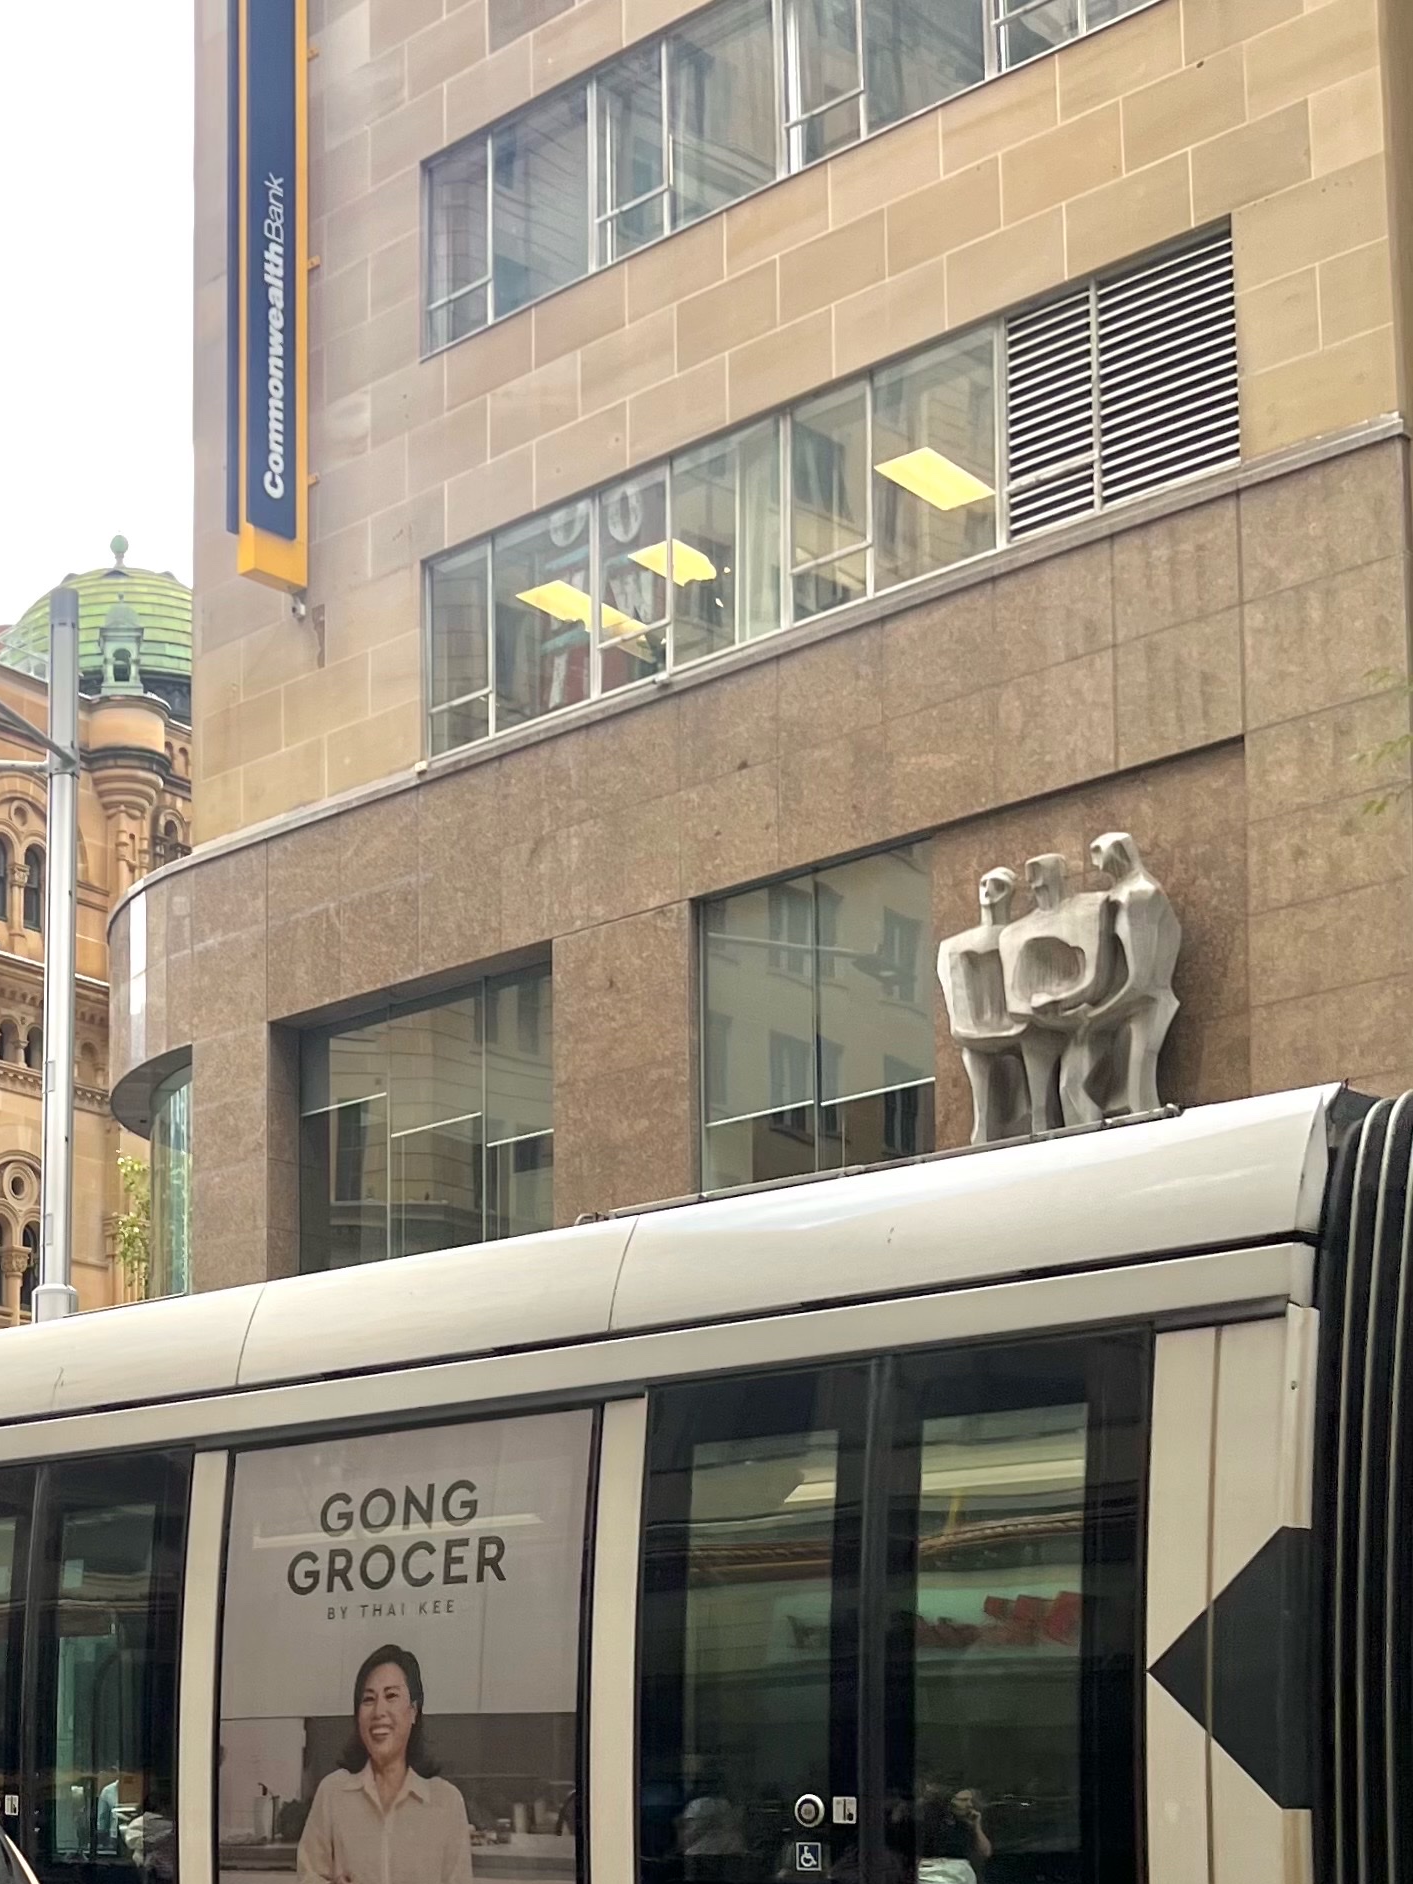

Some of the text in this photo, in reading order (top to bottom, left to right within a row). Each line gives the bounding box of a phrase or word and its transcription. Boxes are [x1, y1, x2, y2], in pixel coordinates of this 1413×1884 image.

[263, 172, 285, 499] CommonwealthBank
[320, 1479, 479, 1537] GONG
[287, 1535, 507, 1596] GROCER
[327, 1600, 455, 1620] BY THAI KEE
